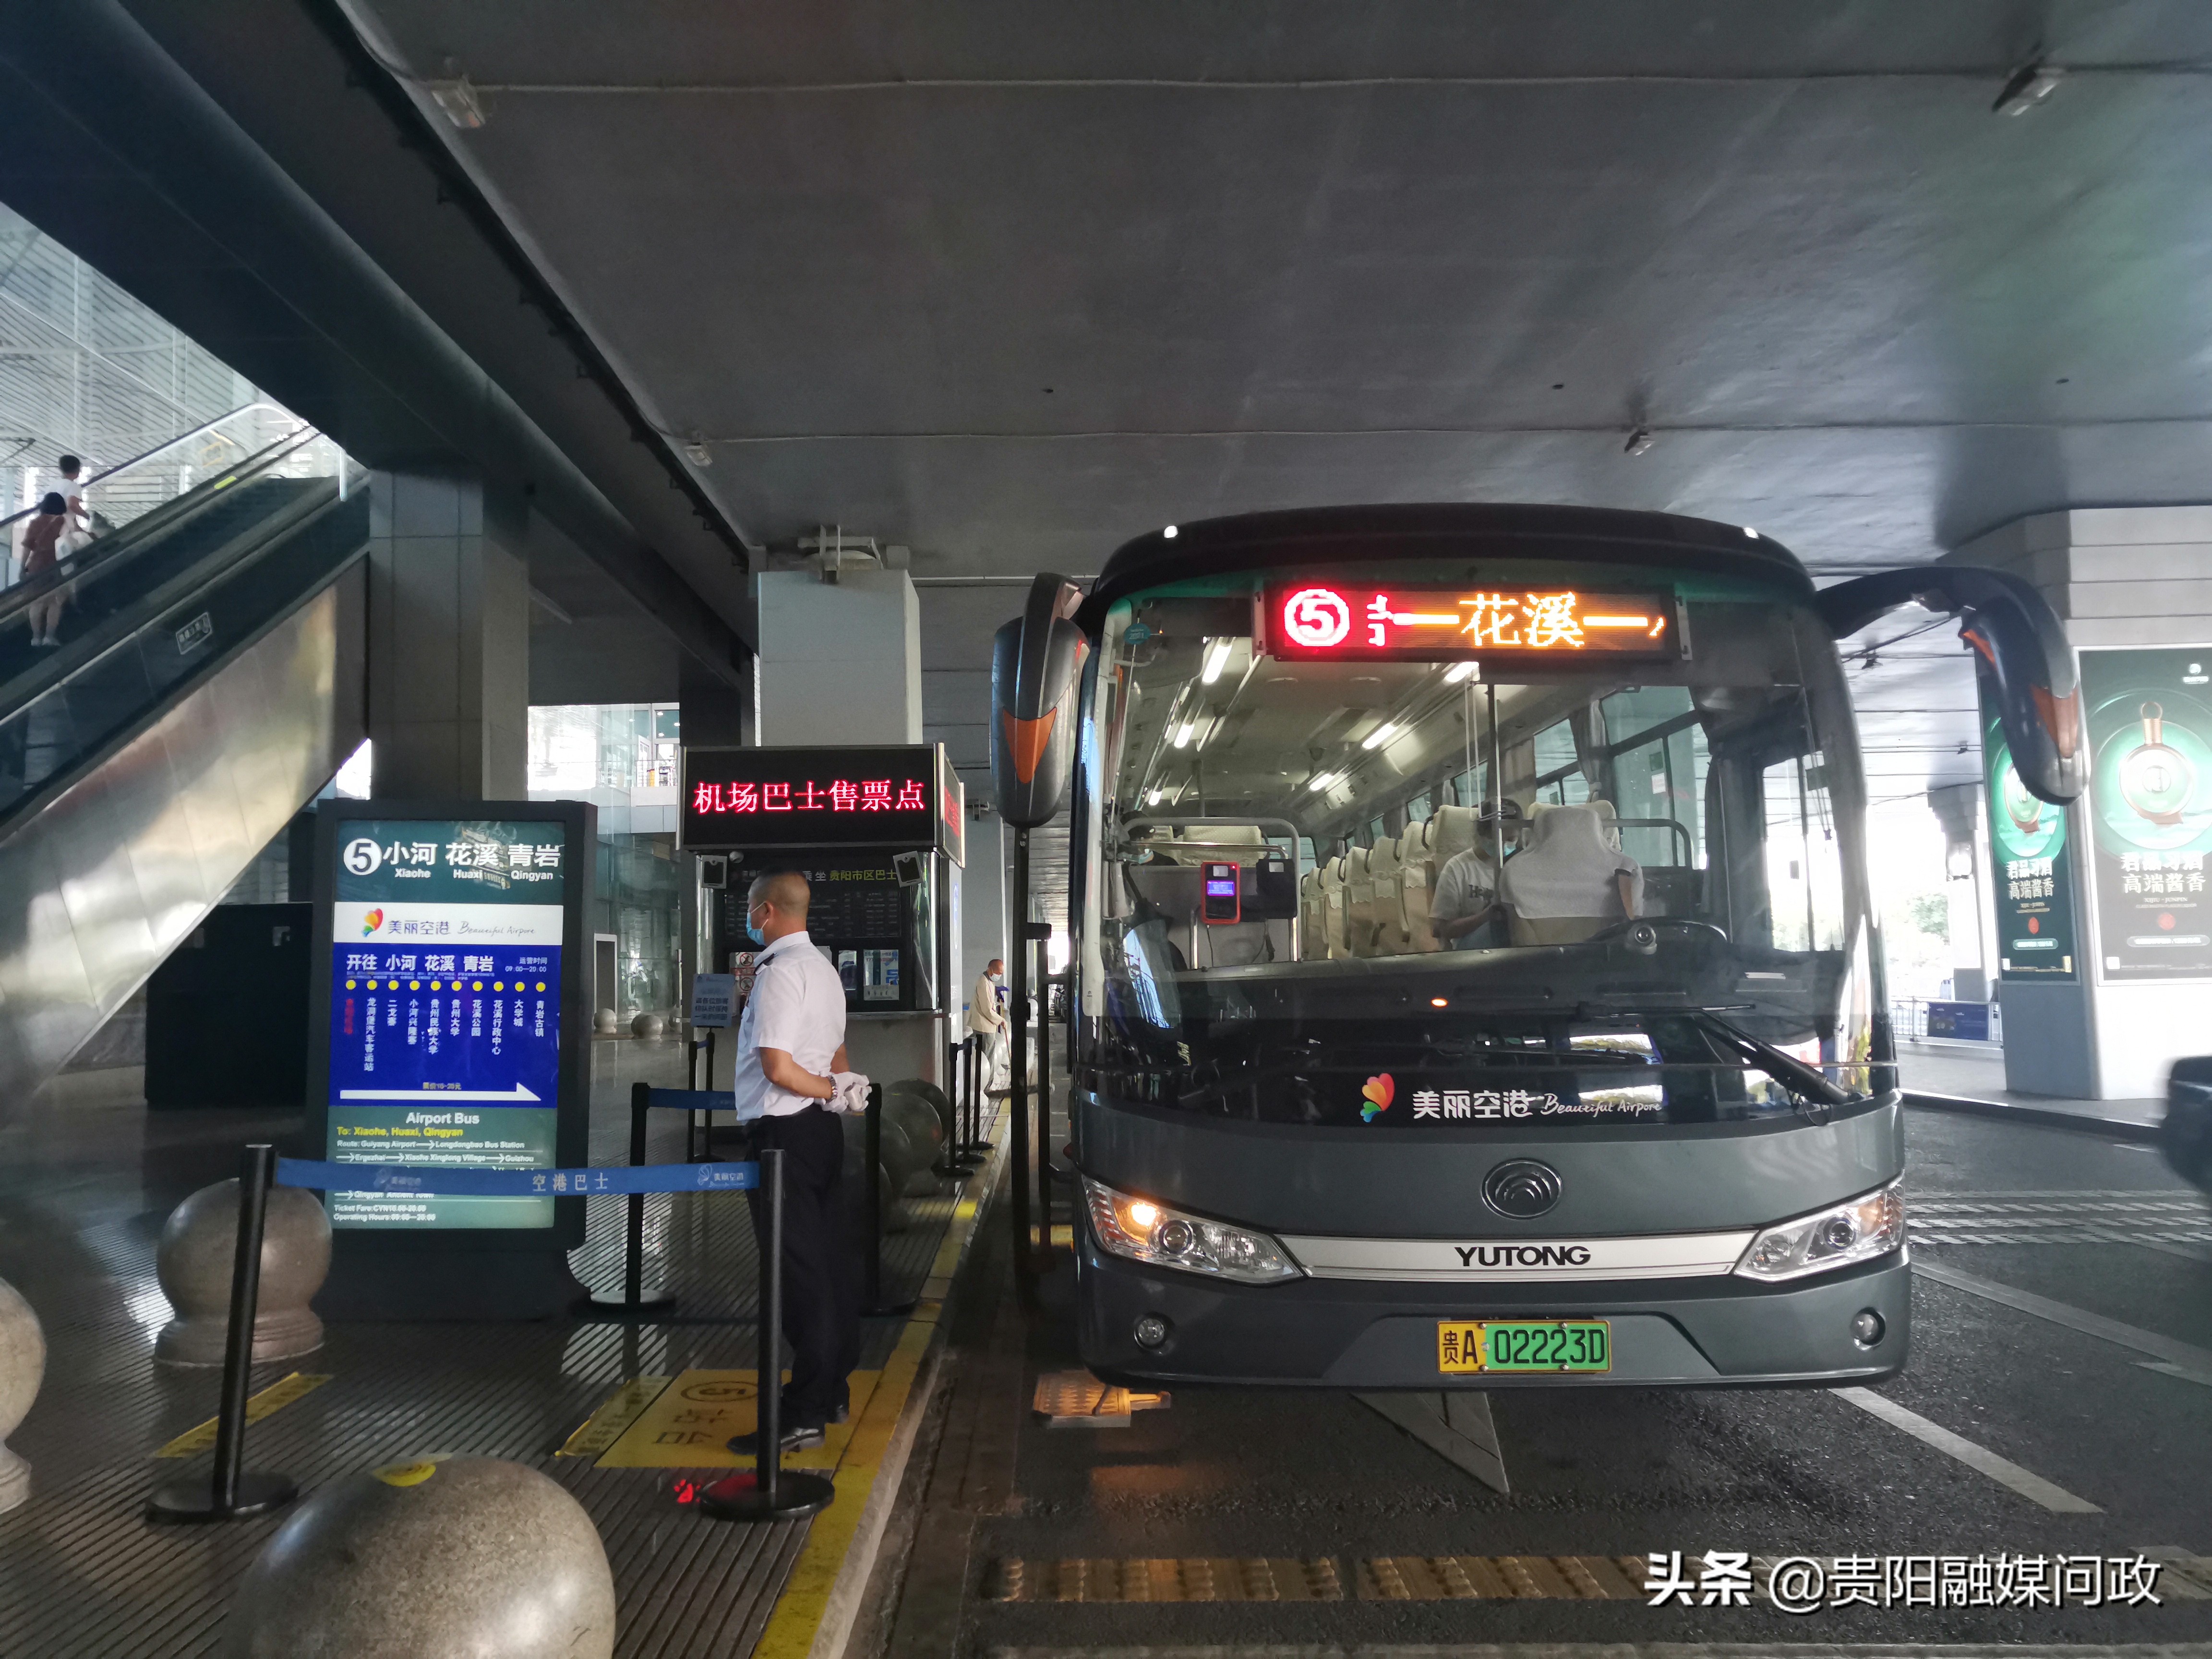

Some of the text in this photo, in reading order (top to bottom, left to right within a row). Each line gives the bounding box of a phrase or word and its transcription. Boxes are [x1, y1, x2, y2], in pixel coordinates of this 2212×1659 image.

[694, 780, 925, 813] 机场巴士售票点
[384, 841, 438, 866] 小河
[445, 842, 500, 866] 花溪
[507, 843, 561, 867] 青岩
[395, 868, 553, 881] Xiaohe Huaxi Qingyan
[2122, 872, 2206, 893] 高端酱香
[2008, 878, 2055, 900] 高端酱香
[387, 920, 450, 935] 美丽空港
[347, 954, 494, 972] 开往 小河 花溪 青岩
[1412, 1090, 1533, 1119] 美丽空港
[406, 1112, 480, 1126] Airport Bus
[423, 1127, 464, 1138] Qingyan
[361, 1140, 390, 1149] Guiyang
[391, 1141, 416, 1149] Airport
[532, 1172, 608, 1192] 空港巴士
[1454, 1246, 1591, 1266] YUTONG
